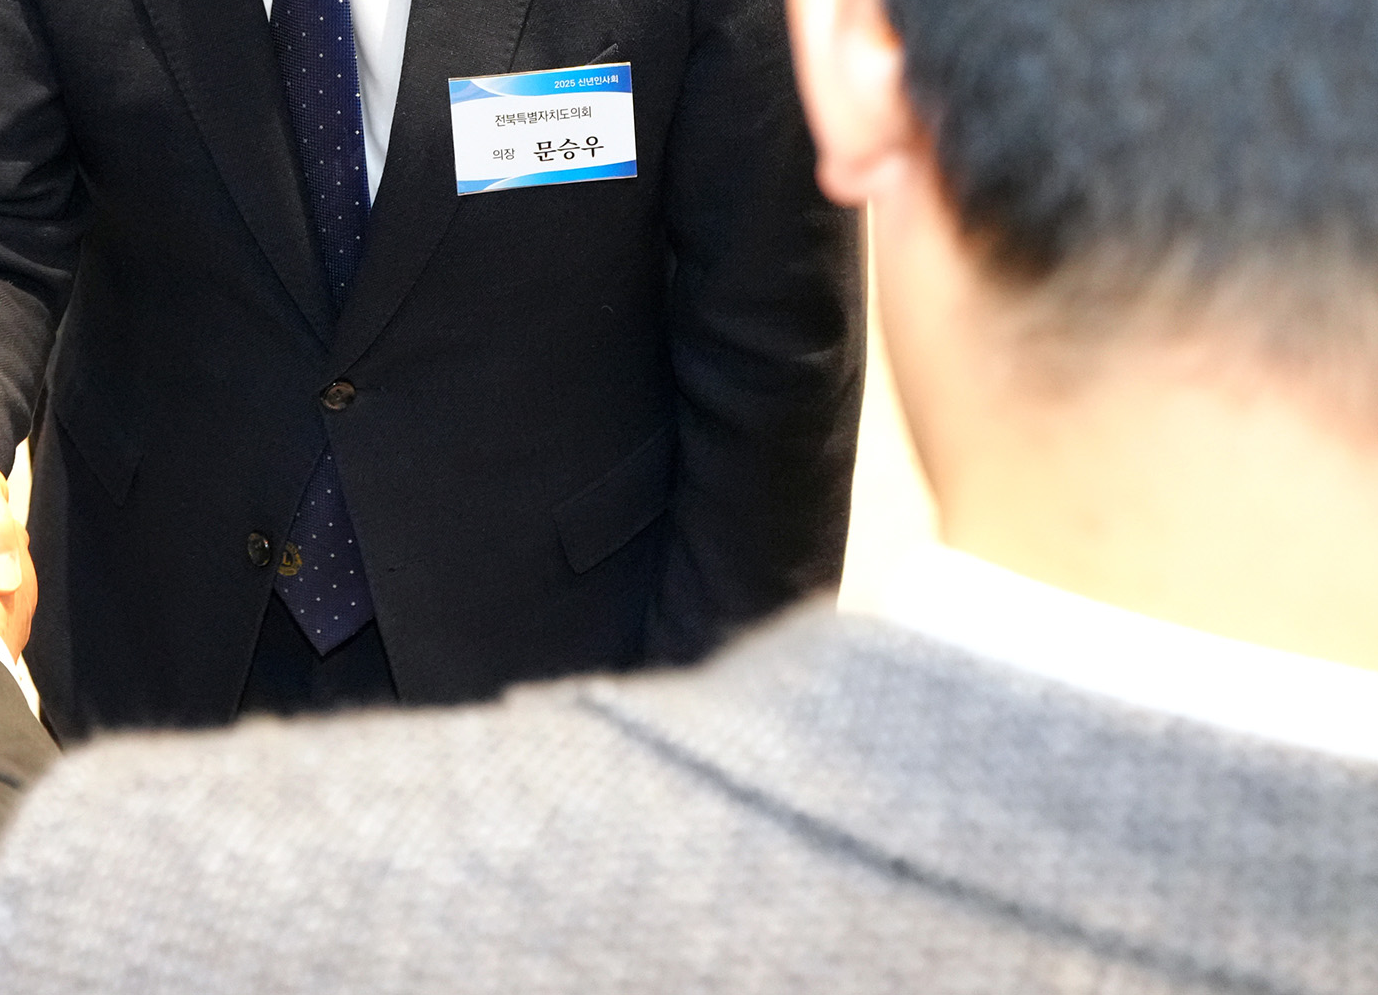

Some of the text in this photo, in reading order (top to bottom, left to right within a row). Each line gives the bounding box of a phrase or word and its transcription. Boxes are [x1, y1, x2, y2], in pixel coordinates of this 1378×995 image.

[554, 74, 619, 89] 2025 신년인사회
[495, 106, 592, 127] 전북특별자치도의회
[492, 136, 604, 162] 의장 문승우
